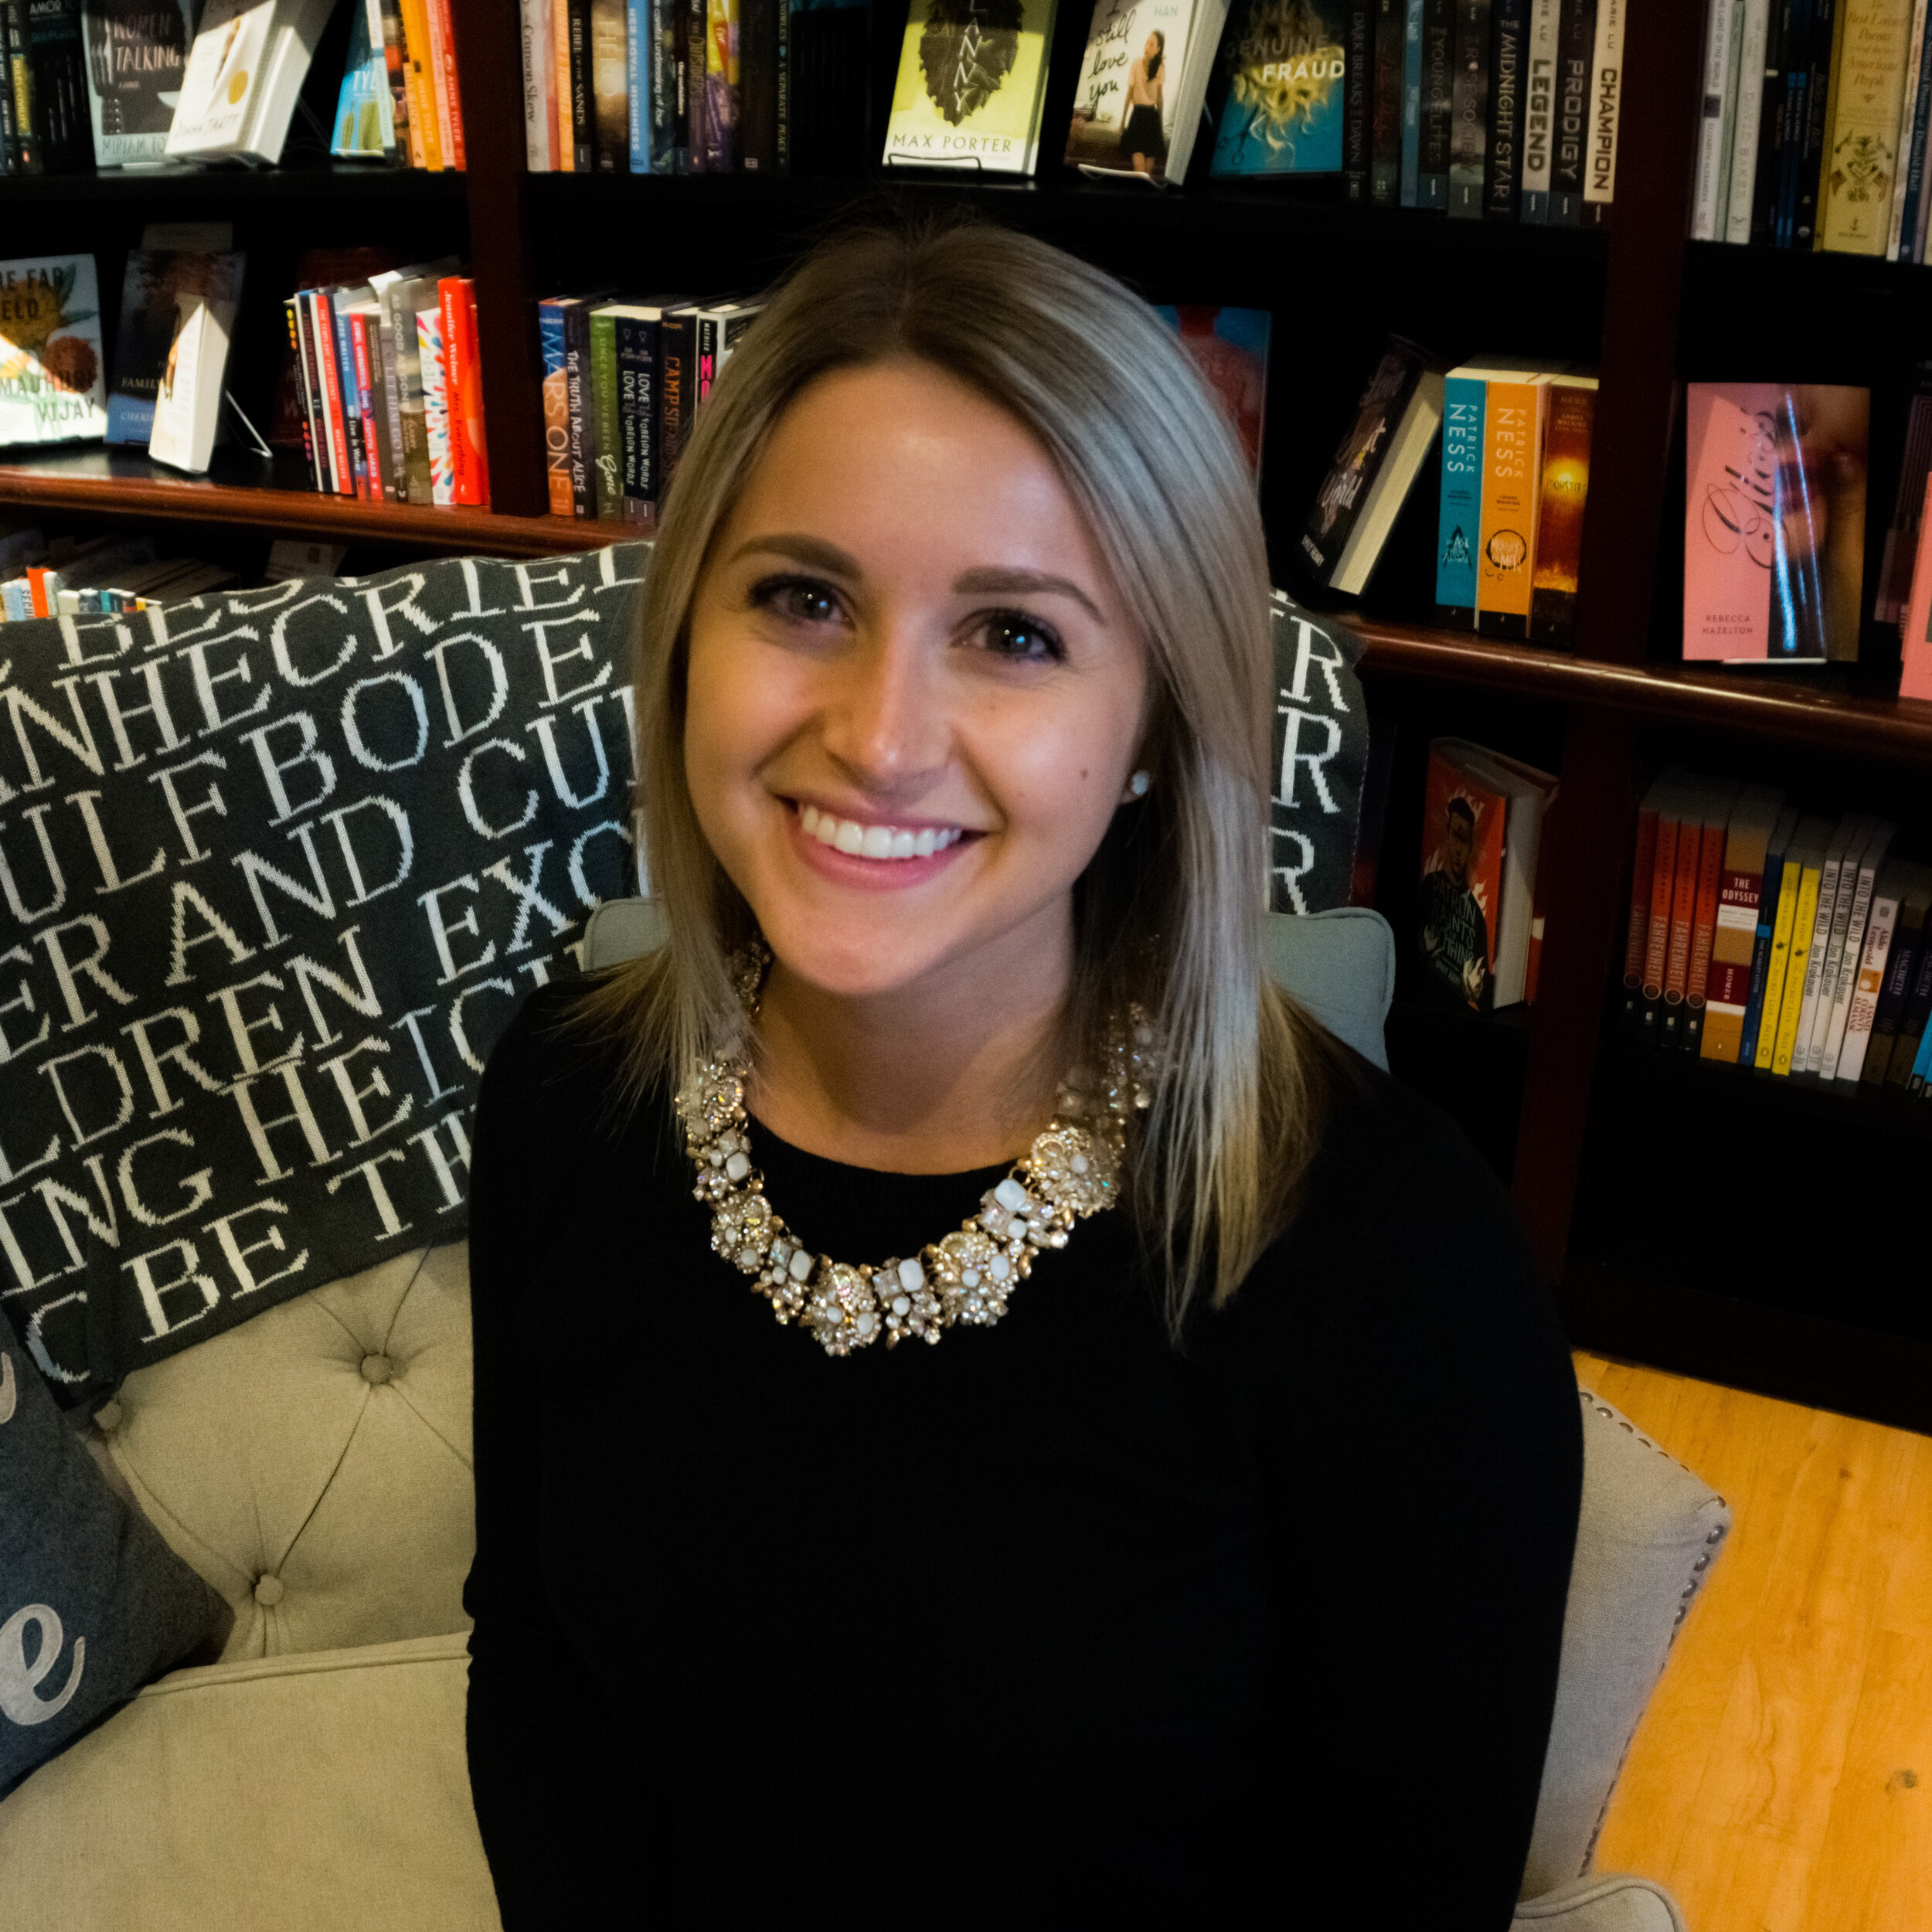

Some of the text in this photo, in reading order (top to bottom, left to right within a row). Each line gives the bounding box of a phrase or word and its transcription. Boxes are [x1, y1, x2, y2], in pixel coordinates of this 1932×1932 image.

[653, 8, 664, 40] careful
[1095, 9, 1137, 46] still
[1154, 5, 1179, 17] HAN
[1716, 10, 1726, 31] LIGHT
[115, 46, 182, 71] TALKING
[598, 21, 620, 97] HERO
[654, 42, 664, 94] undressing
[1088, 49, 1129, 79] love
[1223, 34, 1331, 59] GENUINE
[1262, 60, 1346, 81] FRAUD
[1431, 38, 1445, 99] YOUNG
[522, 25, 539, 122] Crimson Skew
[572, 19, 586, 125] REBEL SANDS
[628, 8, 641, 151] HER ROYAL HIGHNESS
[1089, 80, 1120, 110] you
[1349, 12, 1366, 163] DARK BREAKS DAWN
[1497, 32, 1519, 138] MIDNIGHT
[1711, 62, 1722, 88] WORLD
[447, 75, 463, 142] ANNE TYLER
[1526, 60, 1552, 172] LEGEND
[1560, 60, 1584, 182] PRODIGY
[1593, 67, 1617, 190] CHAMPION
[778, 124, 787, 154] PEACE
[893, 134, 1012, 152] MAX PORTER
[1494, 141, 1513, 199] STAR
[26, 265, 64, 289] FAR
[338, 318, 350, 372] JESS WALTER
[393, 313, 405, 351] GOOD
[444, 291, 458, 386] Jennifer Weiner
[703, 322, 712, 352] MATHIEU
[325, 359, 334, 376] LAST
[385, 366, 396, 392] LET
[566, 350, 579, 372] THE
[664, 356, 681, 406] CAMP
[36, 397, 95, 422] VIJAY
[328, 378, 337, 401] SECRET
[347, 405, 355, 417] We
[387, 395, 400, 427] HIM
[542, 329, 572, 492] MARS ONE
[568, 375, 583, 412] TRUTH
[349, 420, 357, 436] Live
[391, 427, 403, 450] GO
[570, 416, 585, 458] ABOUT
[595, 336, 618, 495] SINCE BEEN Gone
[622, 370, 637, 486] LOVE FOREIGN WORDS
[638, 372, 651, 491] LOVE FOREIGN WORDS
[1447, 403, 1468, 473] NESS
[1465, 405, 1478, 474] PATRICK
[335, 428, 347, 480] MARTIN WALKER
[352, 448, 362, 471] Water
[363, 417, 378, 478] JESMYN WARD
[454, 420, 466, 477] Everything
[1495, 407, 1517, 478] NESS
[1513, 409, 1527, 479] PATRICK
[573, 460, 588, 494] ALICE
[1702, 626, 1753, 635] HAZELTON
[1705, 614, 1751, 623] REBECCA
[164, 794, 417, 988] AND
[1722, 888, 1760, 904] ODYSSEY
[1733, 877, 1750, 889] THE
[1647, 915, 1668, 981] FAHRENHEIT
[1669, 920, 1691, 987] FAHRENHEIT
[1804, 867, 1837, 998] INTO THE WILD Jon Krakauer
[1821, 867, 1855, 998] INTO THE WILD Jon Krakauer
[1835, 874, 1869, 1005] INTO THE WILD Jon Krakauer
[1864, 926, 1881, 965] Leopold
[1877, 928, 1890, 951] Aldo
[1692, 924, 1712, 991] FAHRENHEIT
[1893, 949, 1912, 996] MACBETH
[1724, 968, 1734, 1000] HOMER
[1856, 998, 1870, 1033] COUNTY
[0, 1128, 216, 1298] ING
[121, 1197, 309, 1344] BE
[0, 1603, 86, 1726] e
